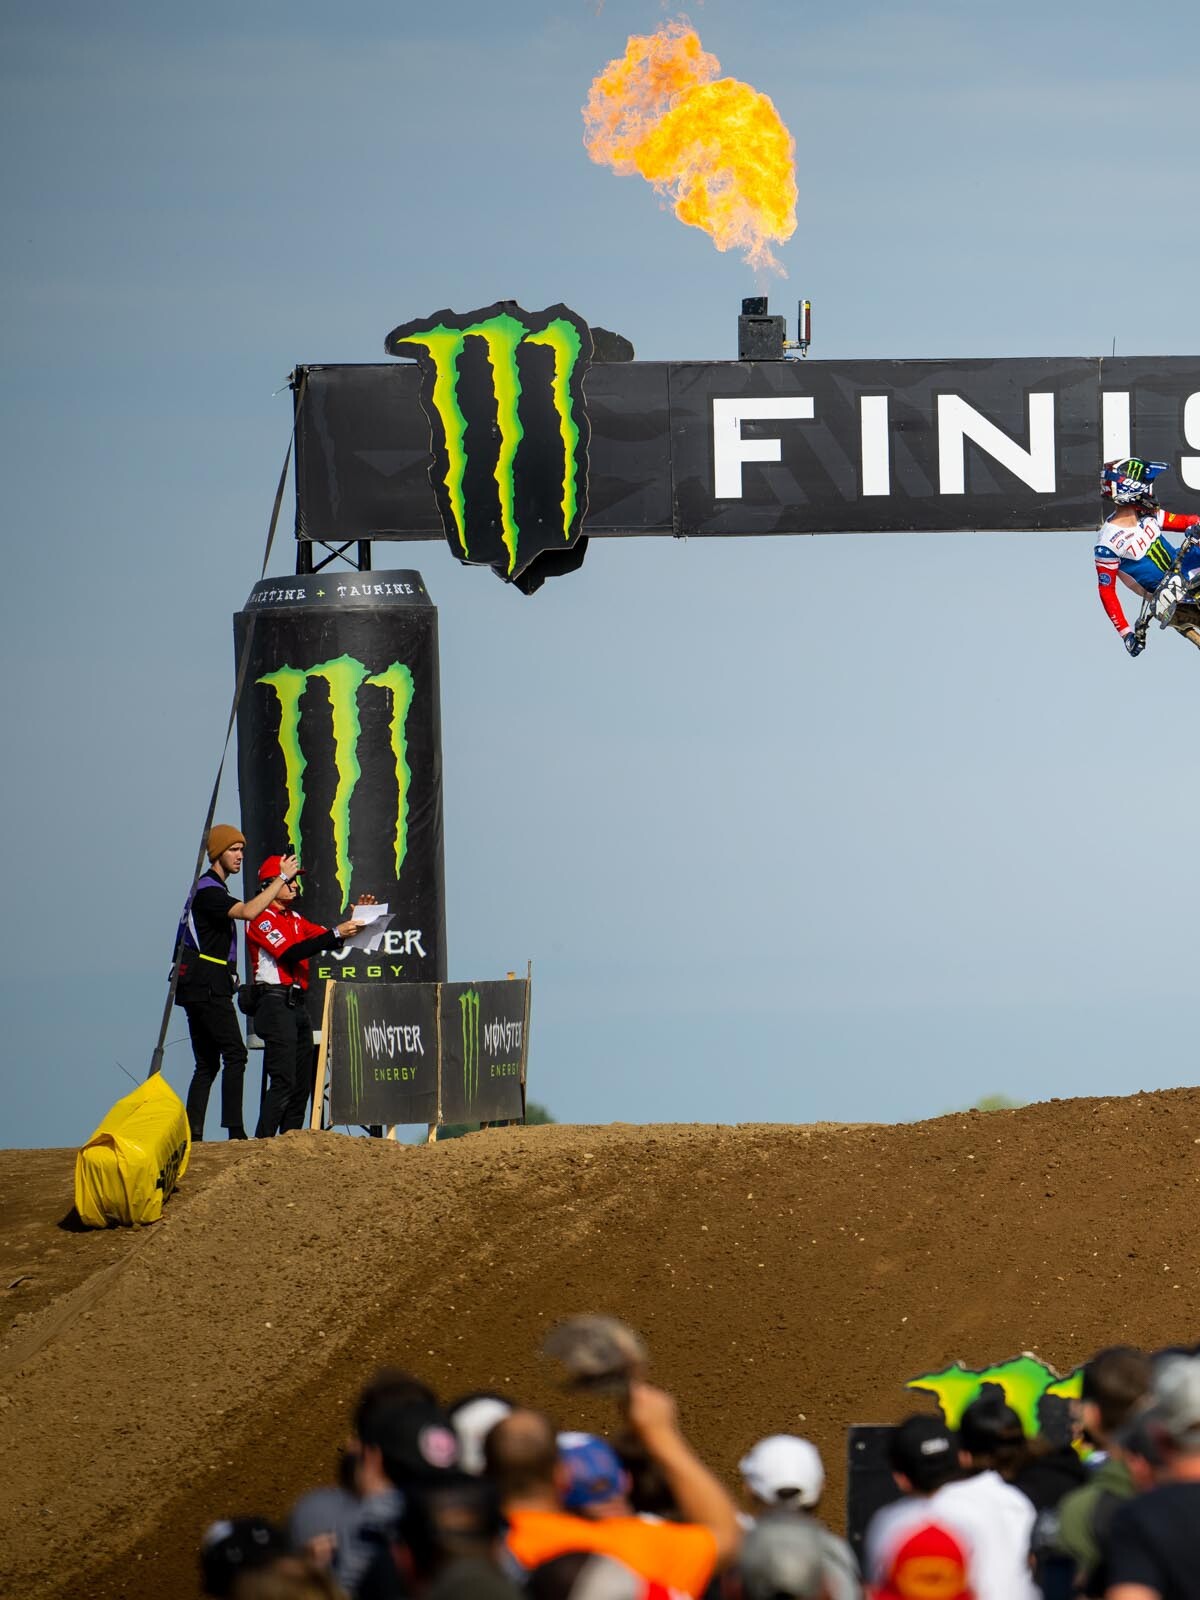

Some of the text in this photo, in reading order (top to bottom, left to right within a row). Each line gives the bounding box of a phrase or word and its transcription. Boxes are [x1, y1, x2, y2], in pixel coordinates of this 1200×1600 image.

[337, 583, 415, 598] TAURINE
[318, 965, 404, 979] ERGY
[363, 1018, 425, 1060] MONSTER
[374, 1067, 417, 1081] ENERGY
